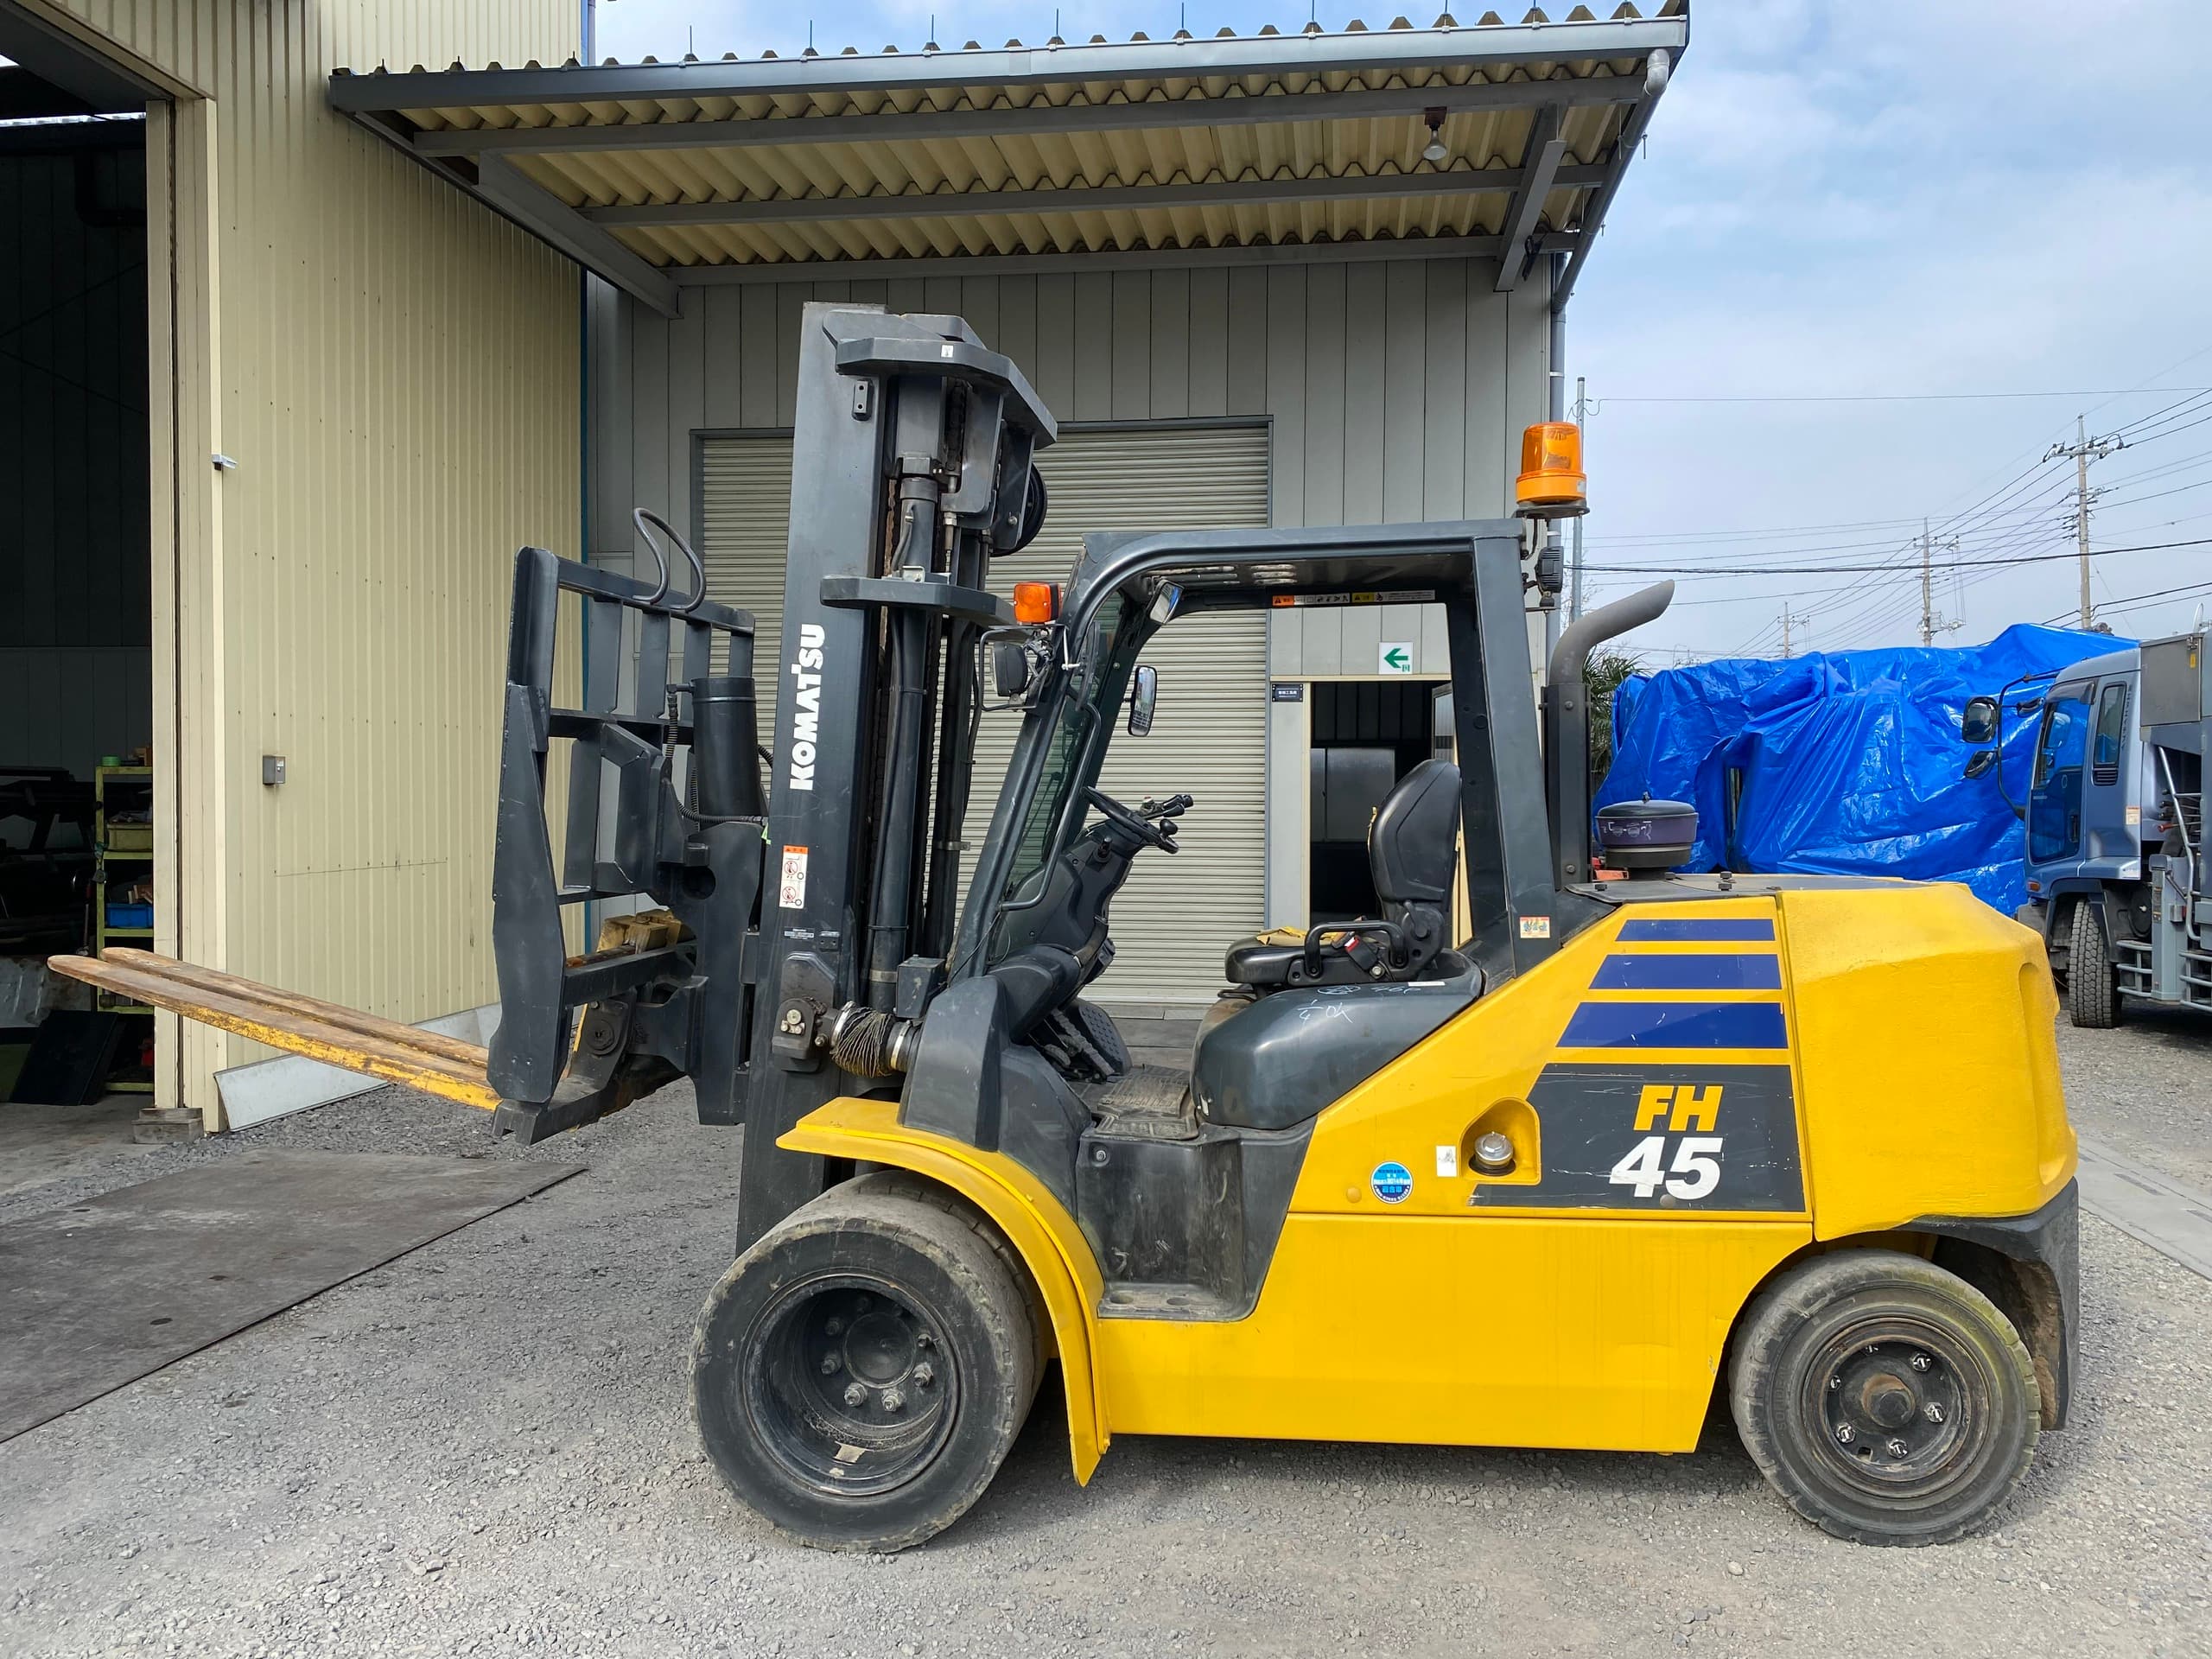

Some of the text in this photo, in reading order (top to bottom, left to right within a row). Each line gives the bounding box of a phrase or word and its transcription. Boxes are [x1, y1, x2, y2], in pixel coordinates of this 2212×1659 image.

[790, 624, 825, 790] KOMATSU
[1633, 1084, 1723, 1131] FH
[1609, 1136, 1723, 1200] 45
